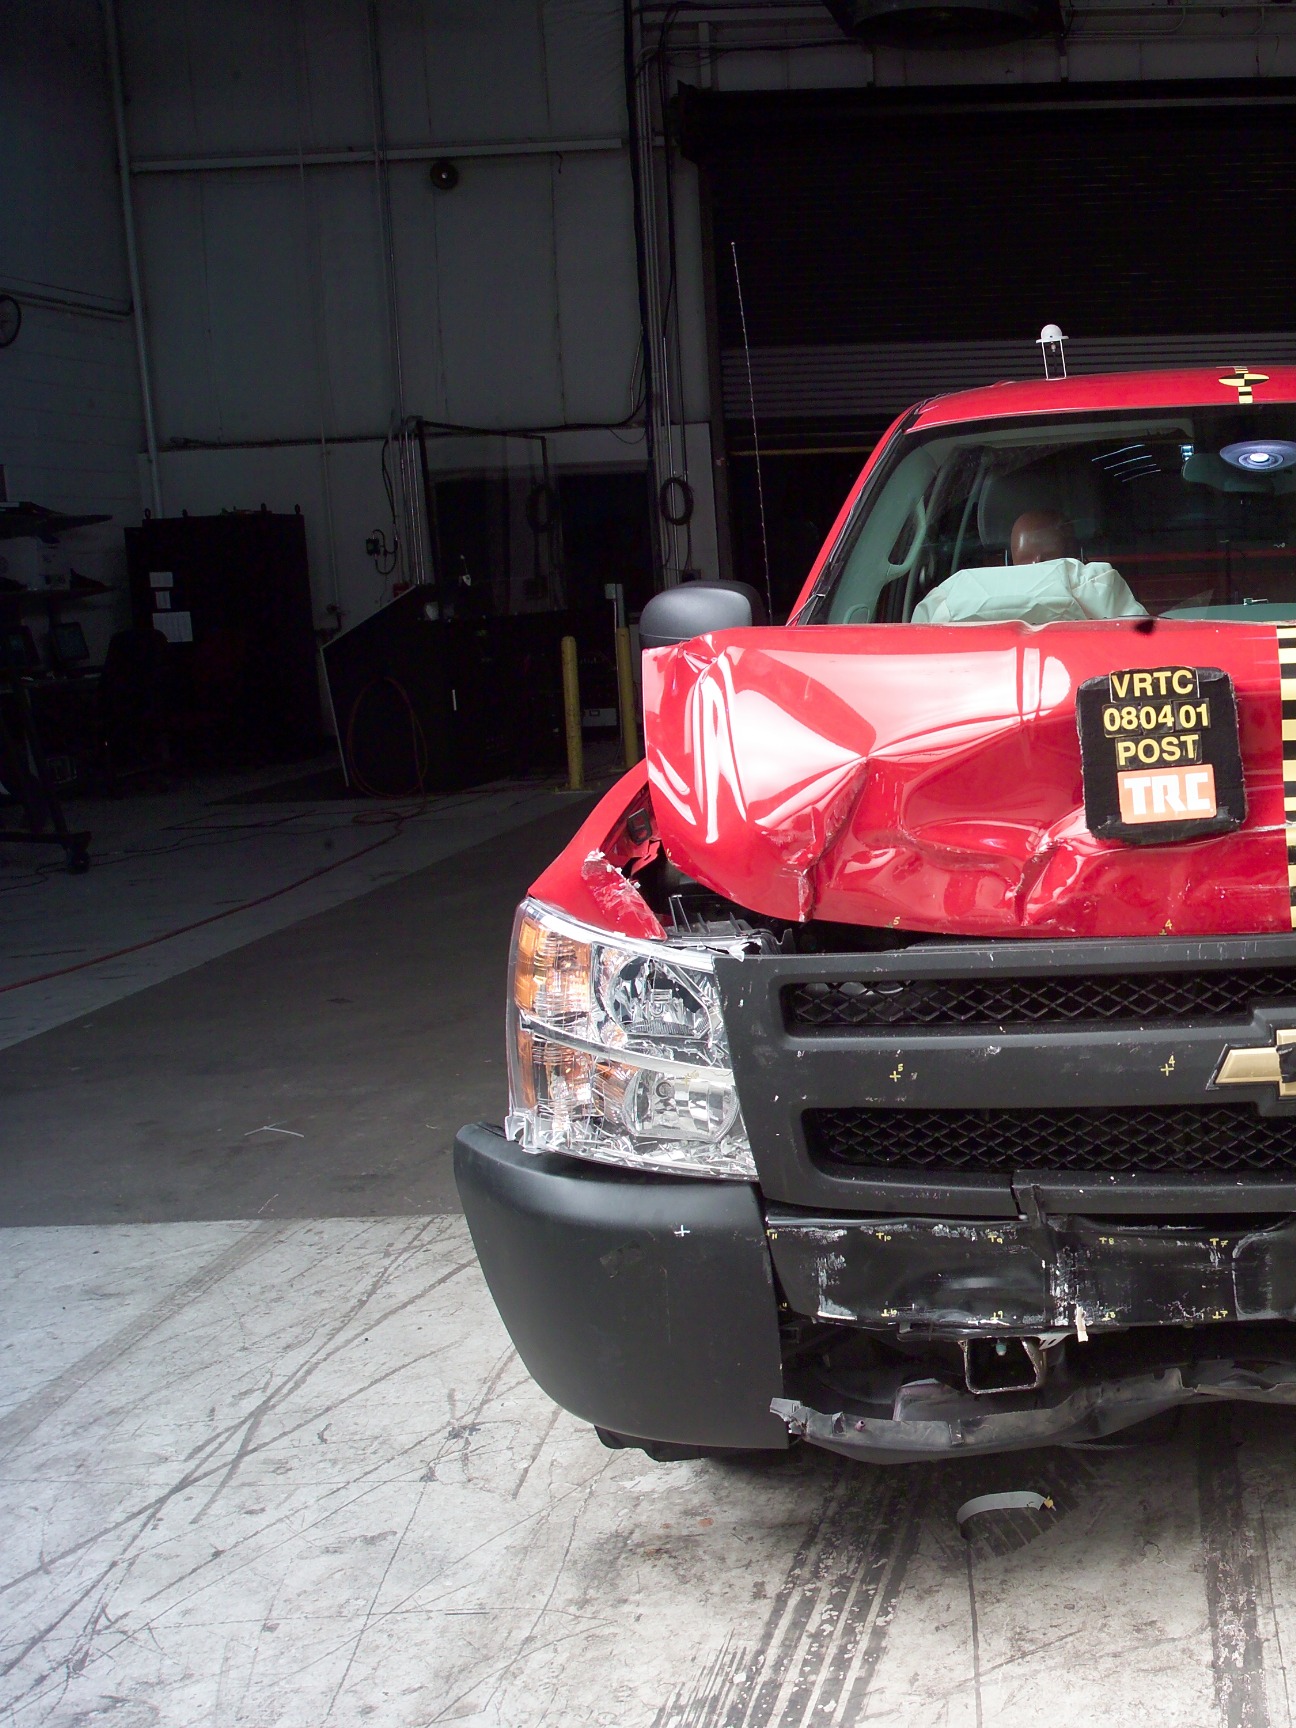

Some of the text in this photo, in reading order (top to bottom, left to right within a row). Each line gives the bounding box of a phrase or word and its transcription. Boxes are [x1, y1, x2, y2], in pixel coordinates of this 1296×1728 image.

[1111, 669, 1196, 699] VRTC
[1117, 734, 1199, 766] POST
[1123, 772, 1211, 815] TRC
[893, 916, 901, 925] 5
[1164, 919, 1173, 930] 4
[1168, 1055, 1176, 1067] 4
[897, 1063, 904, 1072] 5
